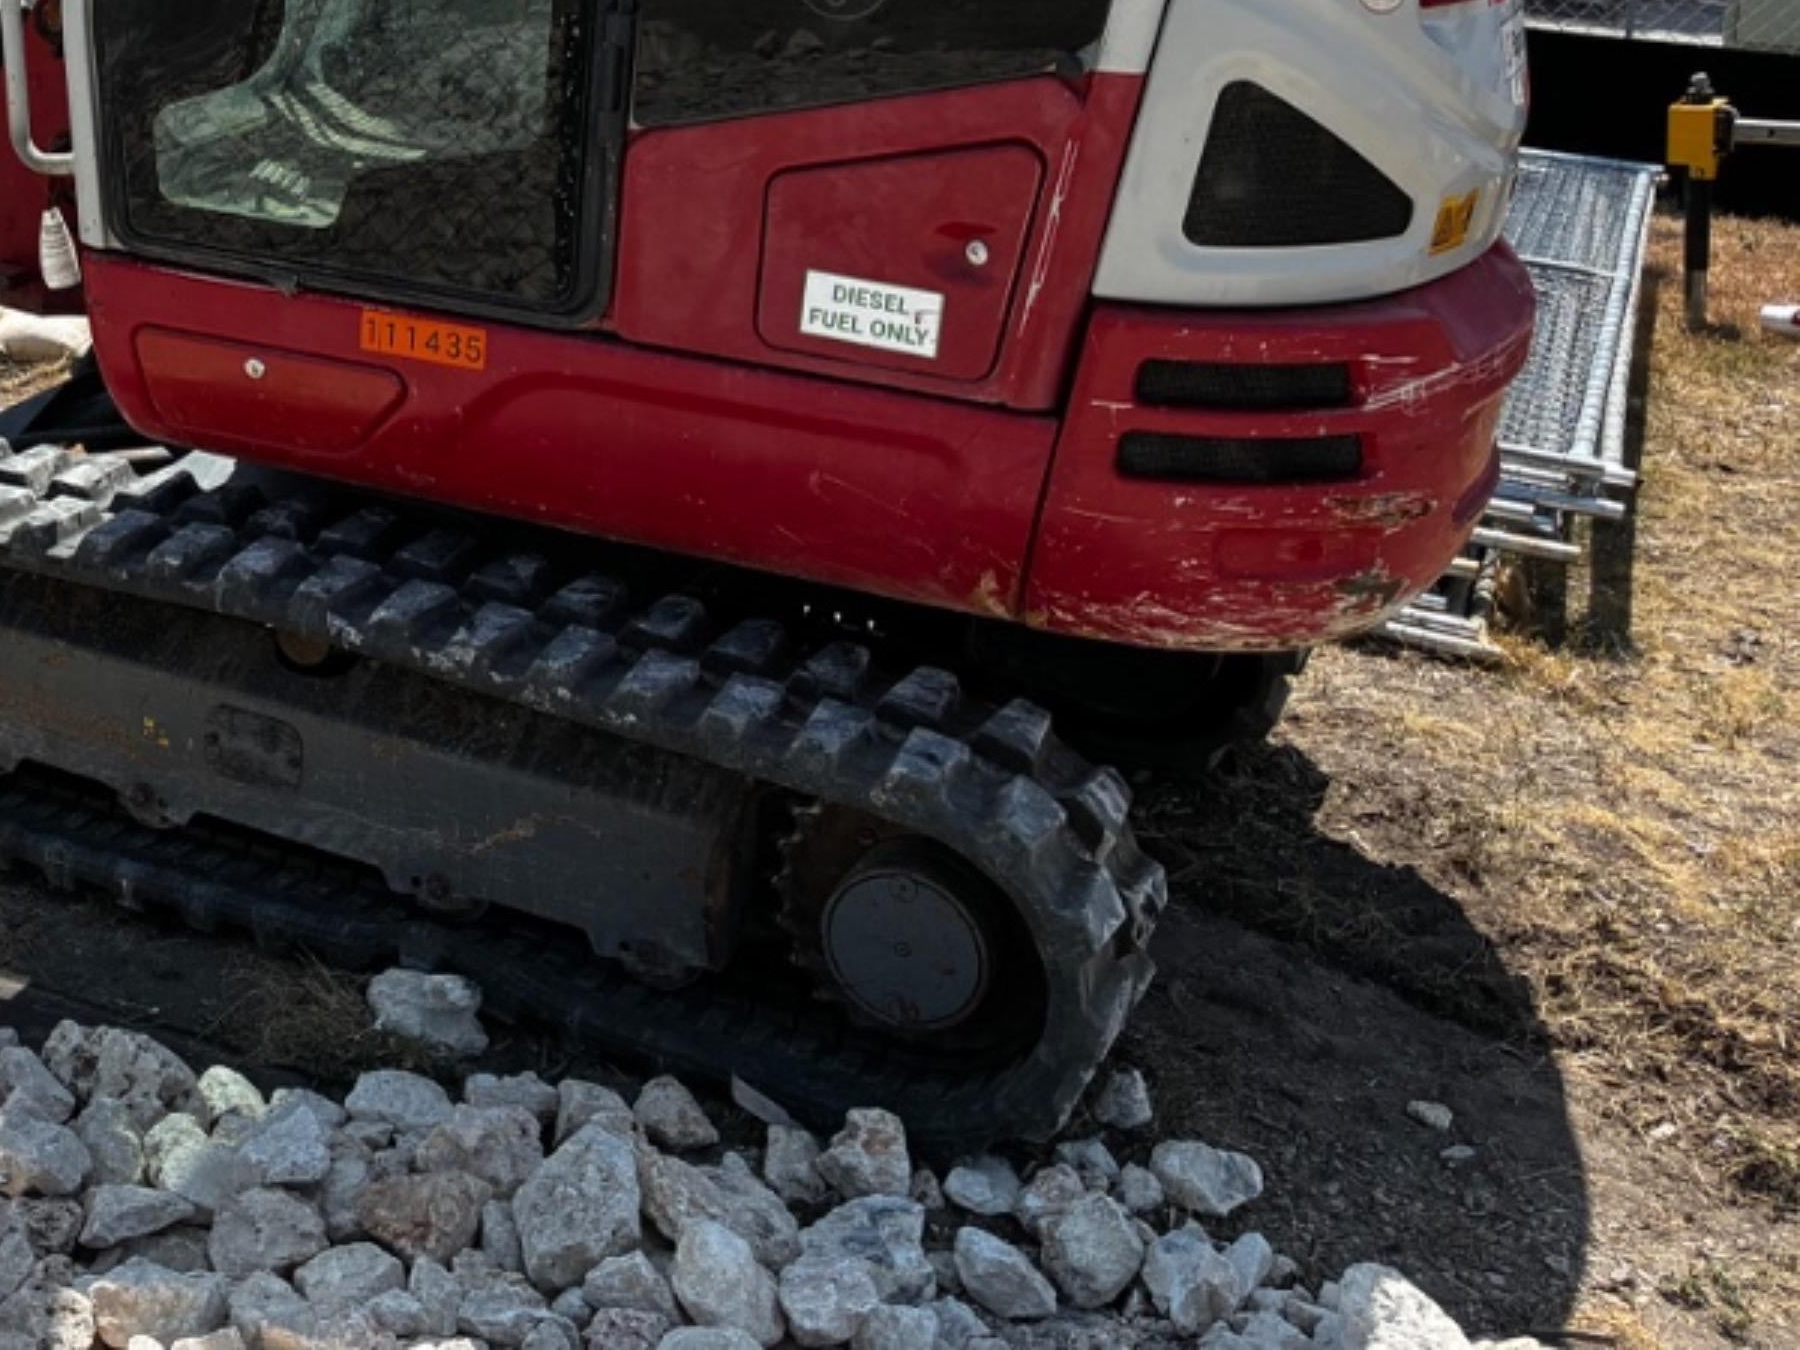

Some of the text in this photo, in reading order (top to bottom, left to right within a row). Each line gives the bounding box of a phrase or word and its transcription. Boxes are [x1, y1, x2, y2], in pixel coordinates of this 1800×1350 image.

[833, 284, 909, 315] DIESEL
[365, 317, 480, 363] 111435
[809, 307, 929, 347] FUEL ONLY
